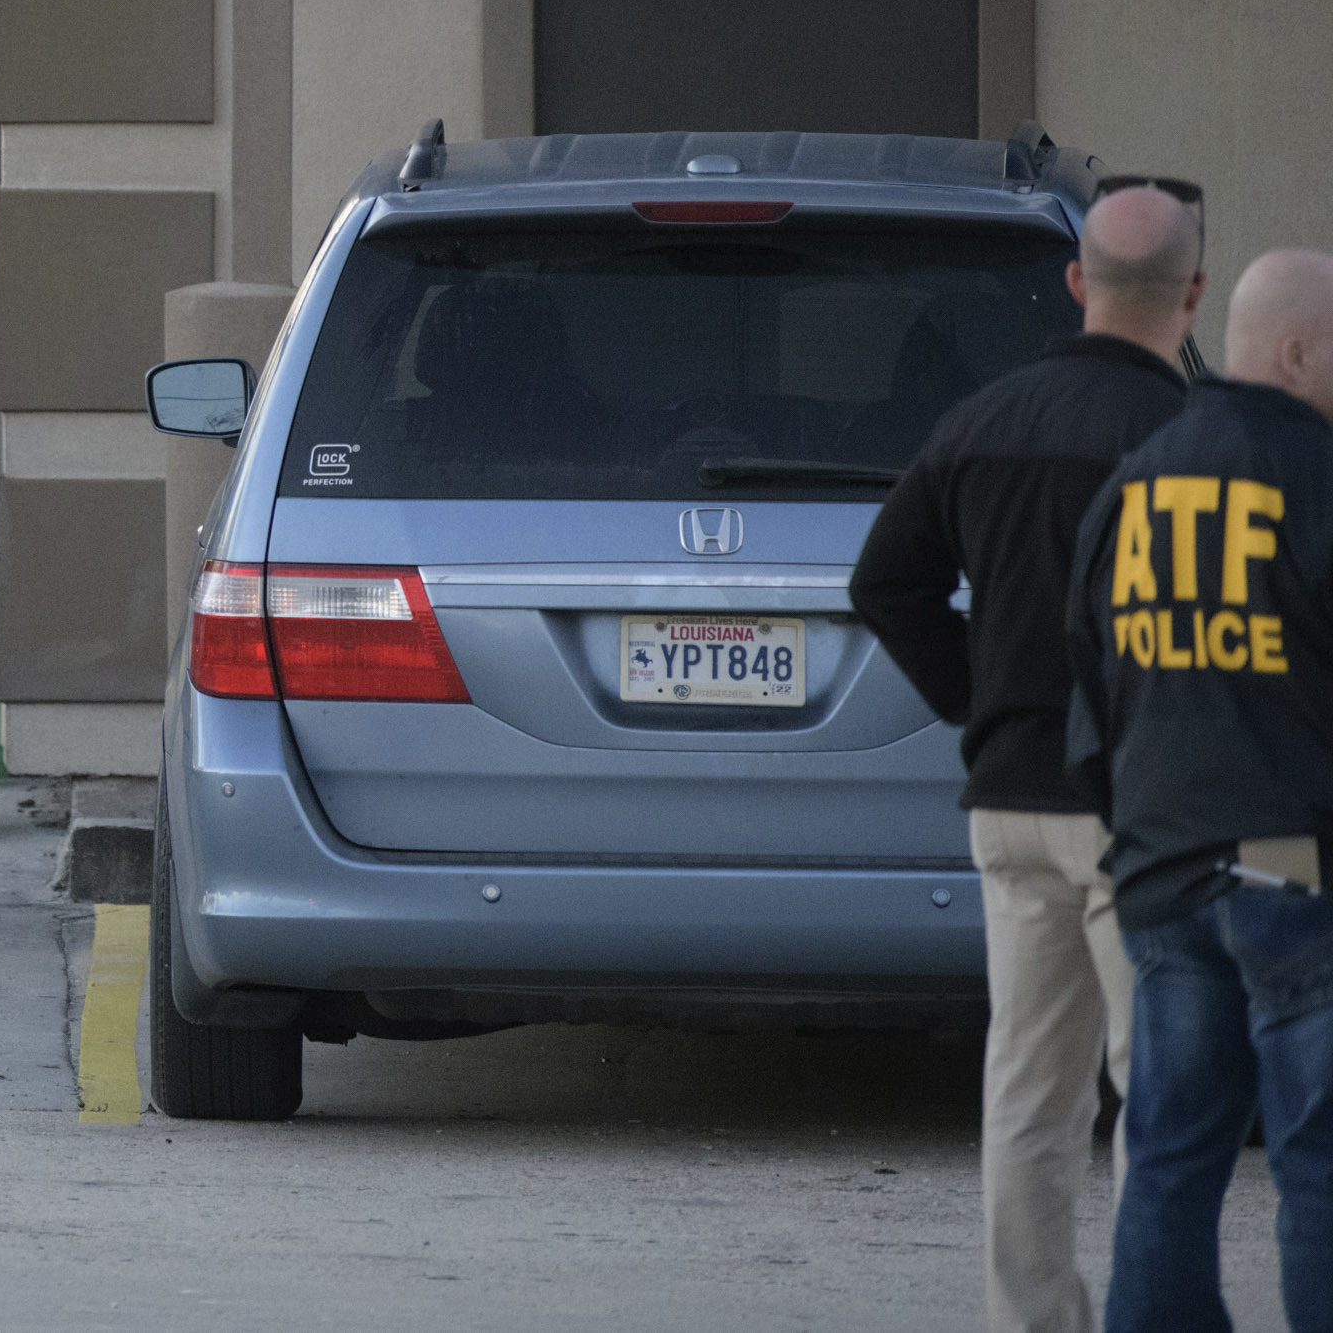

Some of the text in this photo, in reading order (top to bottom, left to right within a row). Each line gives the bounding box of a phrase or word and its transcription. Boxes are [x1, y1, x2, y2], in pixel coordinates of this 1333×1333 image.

[302, 478, 353, 486] PERFECTION
[1111, 475, 1286, 608] ATF
[670, 626, 755, 642] LOUISIANA
[660, 643, 793, 683] YPT848
